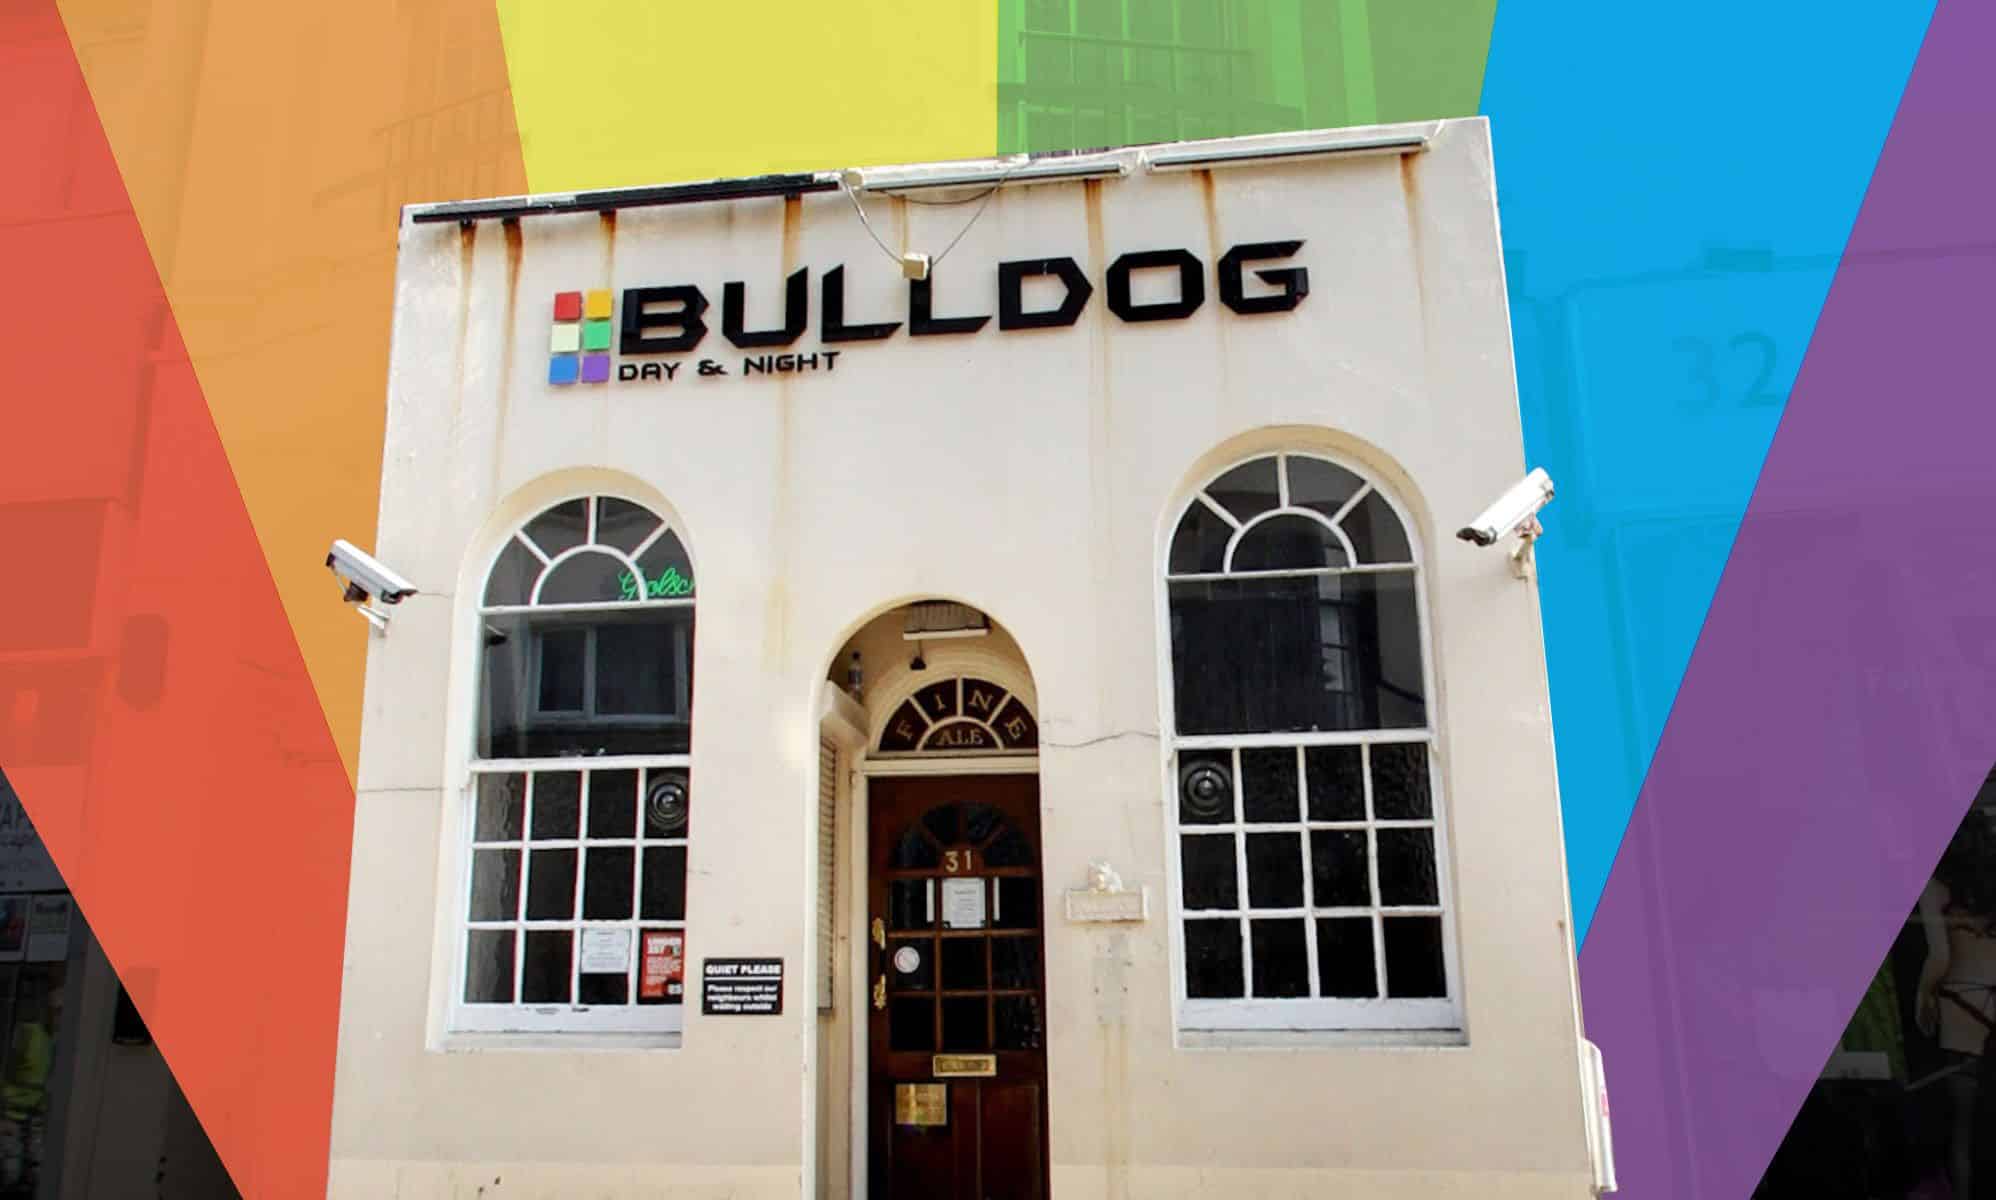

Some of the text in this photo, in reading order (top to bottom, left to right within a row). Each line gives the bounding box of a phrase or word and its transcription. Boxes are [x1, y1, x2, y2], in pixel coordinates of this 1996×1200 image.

[619, 239, 1310, 355] BULLDOG
[618, 351, 841, 382] DAY & NIGHT
[1672, 330, 1783, 417] 32
[618, 566, 696, 600] Golsc
[897, 689, 1028, 741] FINE
[936, 729, 984, 746] ALE
[944, 850, 972, 873] 31
[706, 964, 782, 975] QUIET PLEASE
